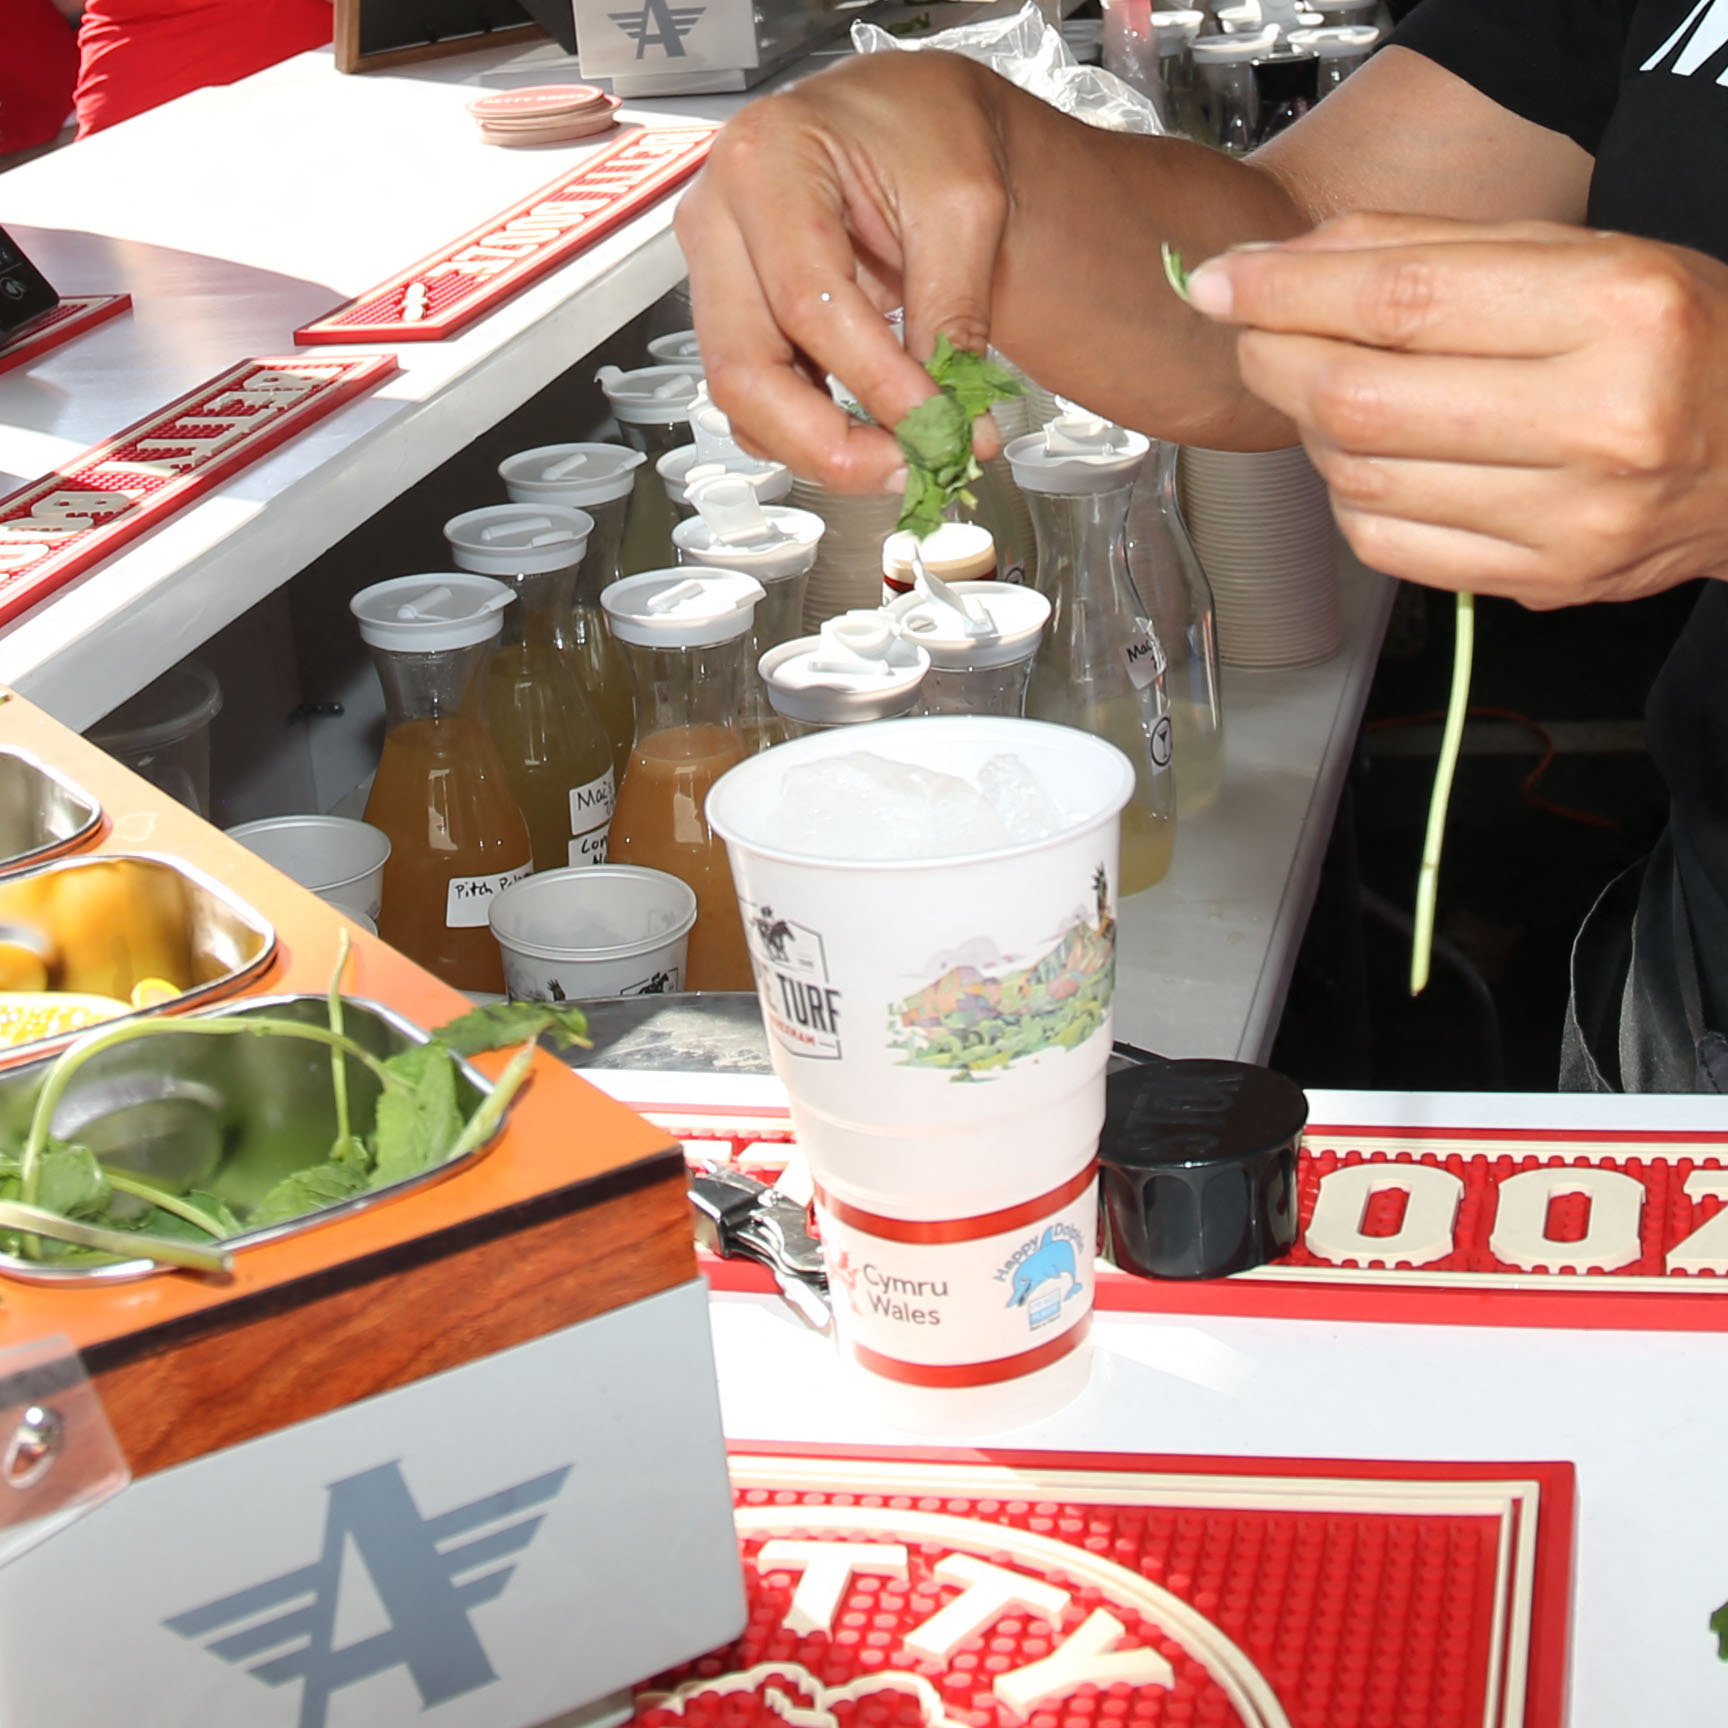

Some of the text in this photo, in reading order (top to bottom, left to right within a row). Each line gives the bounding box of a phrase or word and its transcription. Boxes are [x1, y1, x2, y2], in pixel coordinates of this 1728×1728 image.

[455, 881, 493, 899] Pitch
[777, 973, 841, 1033] TURF
[993, 1235, 1040, 1283] Happy
[863, 1263, 949, 1297] Cymru
[867, 1290, 941, 1325] Wales
